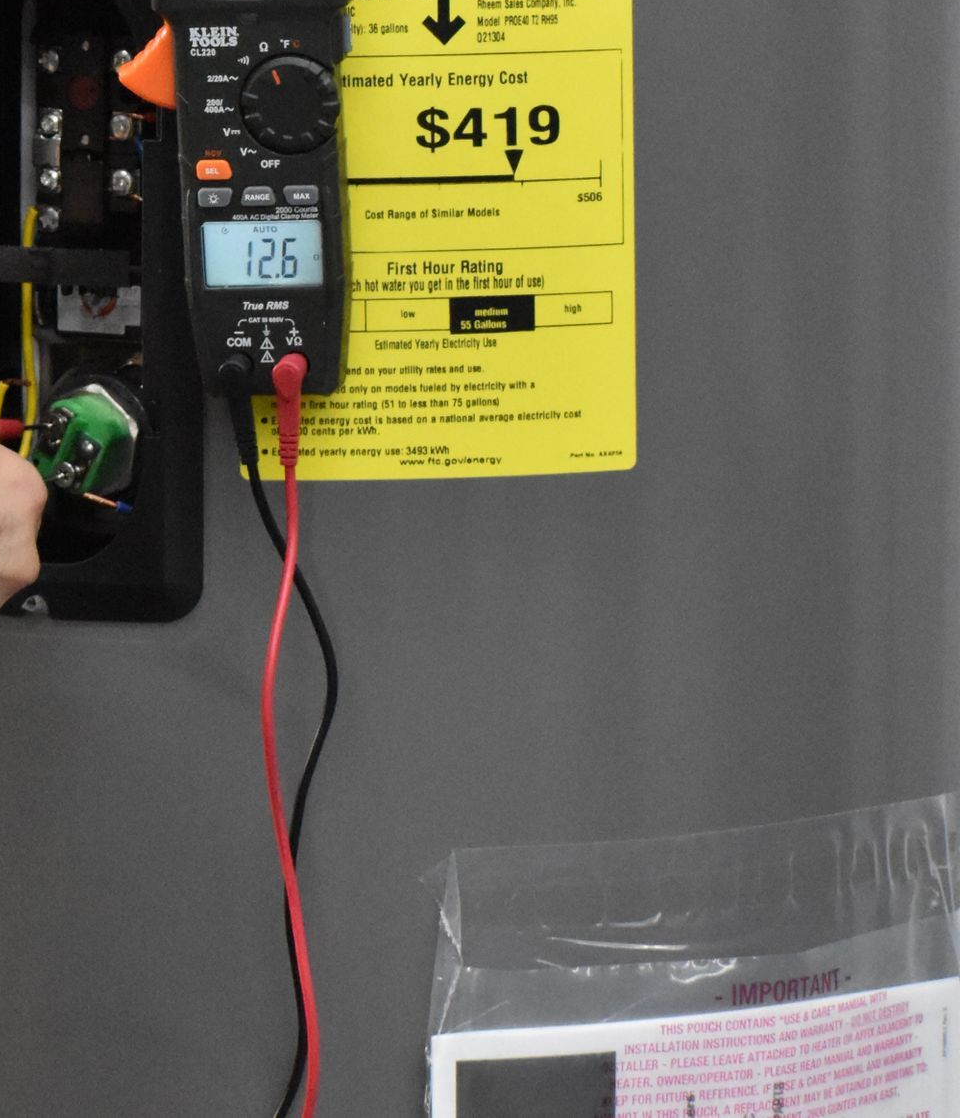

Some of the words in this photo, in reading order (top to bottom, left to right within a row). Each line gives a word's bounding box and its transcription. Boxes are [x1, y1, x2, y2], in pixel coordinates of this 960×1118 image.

[477, 0, 502, 10] Rheem
[504, 0, 524, 9] Sales
[477, 16, 500, 28] Model
[189, 26, 239, 38] KLEIN
[368, 24, 378, 34] 36
[380, 23, 408, 35] gallons
[190, 37, 238, 48] TOOLS
[190, 48, 216, 58] CL220
[342, 72, 394, 89] timated
[400, 72, 442, 90] Yearly
[448, 72, 494, 88] Energy
[500, 70, 528, 84] Cost
[416, 104, 560, 153] $419
[260, 160, 280, 170] OFF
[577, 192, 603, 203] $506
[275, 206, 292, 214] 2000
[294, 206, 318, 214] Counts
[365, 210, 384, 220] Cost
[388, 210, 416, 220] Range
[420, 209, 429, 219] of
[432, 208, 464, 218] Similar
[468, 207, 500, 218] Models
[252, 226, 278, 234] AUTO
[246, 238, 298, 279] 12.6
[387, 261, 417, 276] First
[423, 260, 455, 274] Hour
[461, 260, 504, 275] Rating
[365, 280, 378, 292] hot
[382, 279, 406, 292] water
[409, 281, 424, 294] you
[428, 279, 442, 294] get
[444, 278, 453, 290] in
[456, 278, 470, 290] the
[474, 277, 490, 290] first
[494, 276, 512, 288] hour
[516, 276, 524, 288] of
[527, 275, 545, 289] use)
[243, 302, 264, 310] True
[266, 300, 290, 310] RMS
[564, 303, 582, 315] high
[400, 310, 416, 319] low
[474, 306, 508, 318] medium
[460, 320, 472, 330] 55
[474, 319, 508, 330] Gallons
[226, 337, 252, 348] COM
[374, 338, 413, 350] Estimated
[416, 338, 440, 351] Yearly
[442, 337, 480, 350] Electricity
[483, 337, 497, 348] Use
[378, 367, 396, 377] your
[400, 364, 423, 376] utility
[426, 364, 446, 374] rates
[449, 364, 464, 374] and
[349, 384, 368, 395] only
[371, 386, 382, 394] on
[385, 384, 416, 394] models
[419, 383, 447, 393] fueled
[450, 382, 460, 393] by
[464, 382, 506, 392] electricity
[509, 381, 527, 390] with
[309, 400, 326, 410] first
[330, 400, 349, 410] hour
[352, 399, 376, 410] rating
[382, 398, 394, 410] (51
[398, 400, 407, 408] to
[410, 399, 427, 408] less
[430, 398, 448, 408] than
[452, 398, 463, 407] 75
[466, 397, 500, 409] gallons)
[318, 418, 350, 427] energy
[353, 416, 372, 426] cost
[374, 416, 383, 425] is
[386, 415, 412, 424] based
[416, 416, 427, 424] on
[440, 413, 476, 424] national
[479, 414, 514, 424] average
[518, 410, 562, 422] electricity
[564, 410, 582, 419] cost
[311, 427, 336, 436] cents
[338, 428, 354, 437] per
[319, 447, 347, 458] yearly
[350, 448, 382, 459] energy
[406, 446, 428, 456] 3493
[430, 446, 450, 456] kWh
[732, 967, 840, 1007] IMPORTANT
[661, 1024, 684, 1036] THIS
[687, 1021, 722, 1034] POUCH
[725, 1016, 776, 1032] CONTAINS
[624, 1039, 700, 1056] INSTALLATION
[702, 1032, 776, 1049] INSTRUCTIONS
[778, 1030, 798, 1042] AND
[800, 1018, 844, 1038] WARRANTY
[670, 1054, 709, 1070] PLEASE
[712, 1052, 744, 1066] LEAVE
[747, 1048, 797, 1064] ATTACHED
[800, 1044, 810, 1055] TO
[812, 1036, 842, 1052] HEATER
[613, 1077, 654, 1090] EATER.
[656, 1068, 754, 1087] OWNER/OPERATOR
[764, 1062, 798, 1078] PLEASE
[800, 1057, 822, 1072] READ
[632, 1092, 652, 1105] FOR
[763, 1082, 773, 1094] IF
